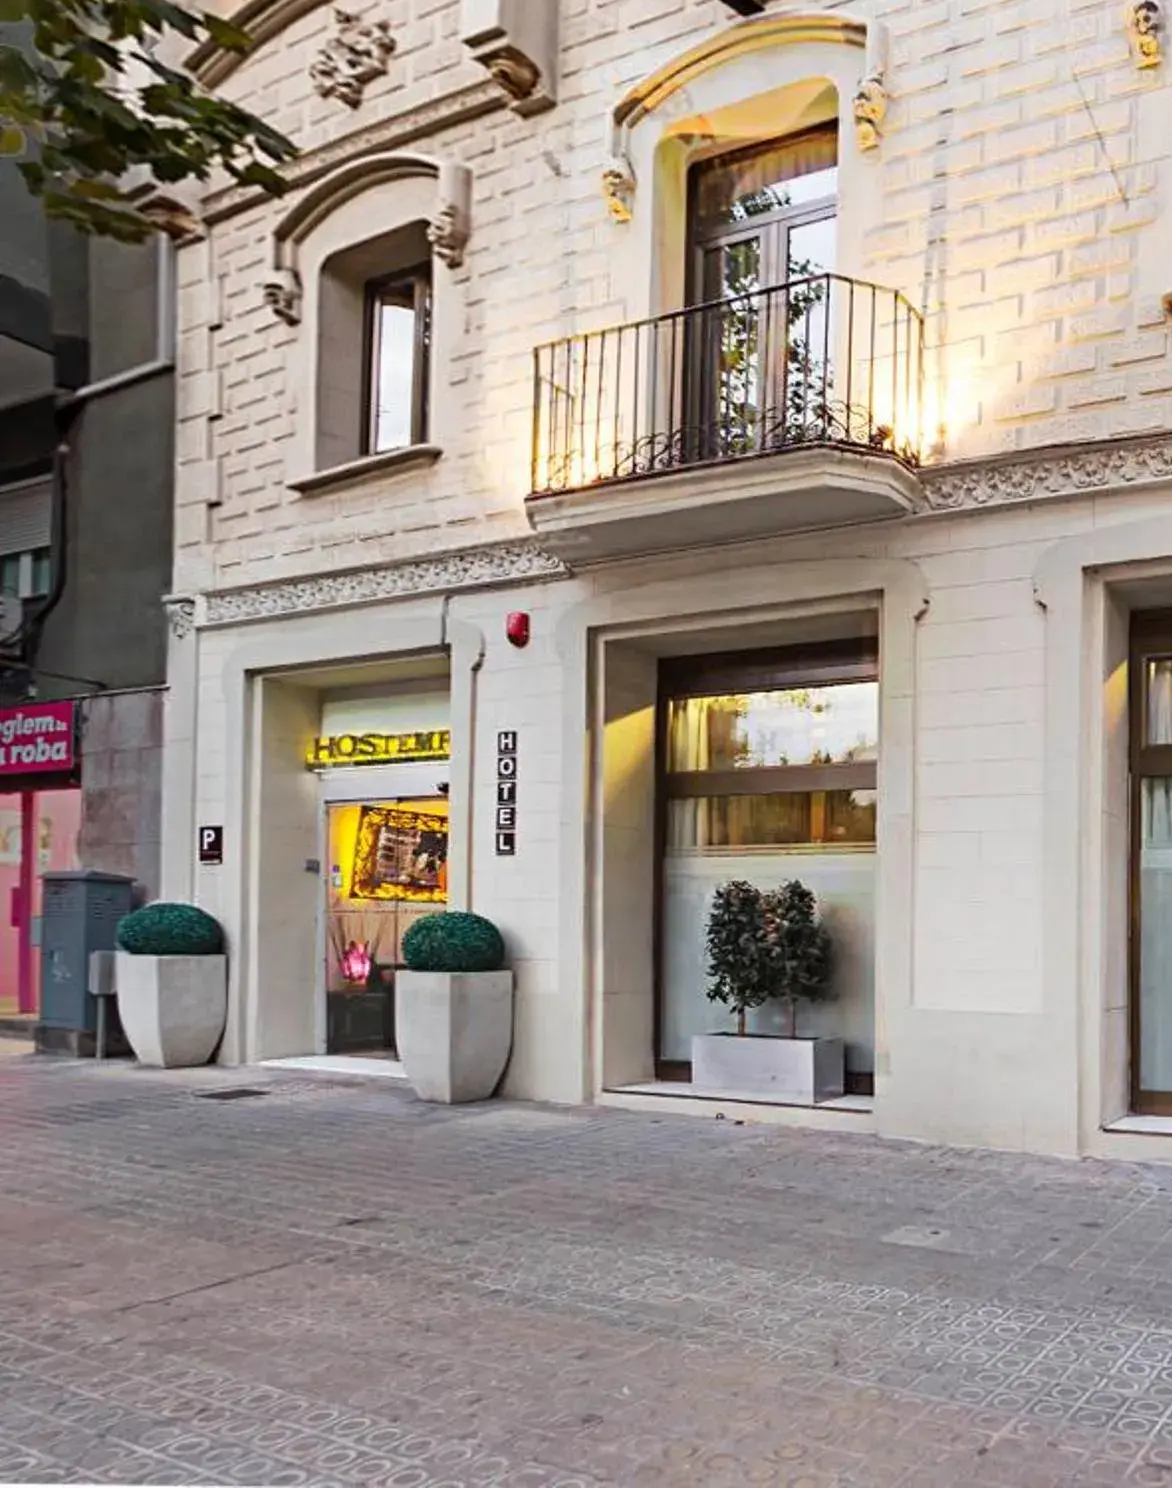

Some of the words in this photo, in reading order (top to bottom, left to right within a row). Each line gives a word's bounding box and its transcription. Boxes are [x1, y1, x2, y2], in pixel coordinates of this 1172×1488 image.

[10, 735, 67, 765] roba
[498, 733, 515, 850] HOTEL
[203, 828, 216, 850] P
